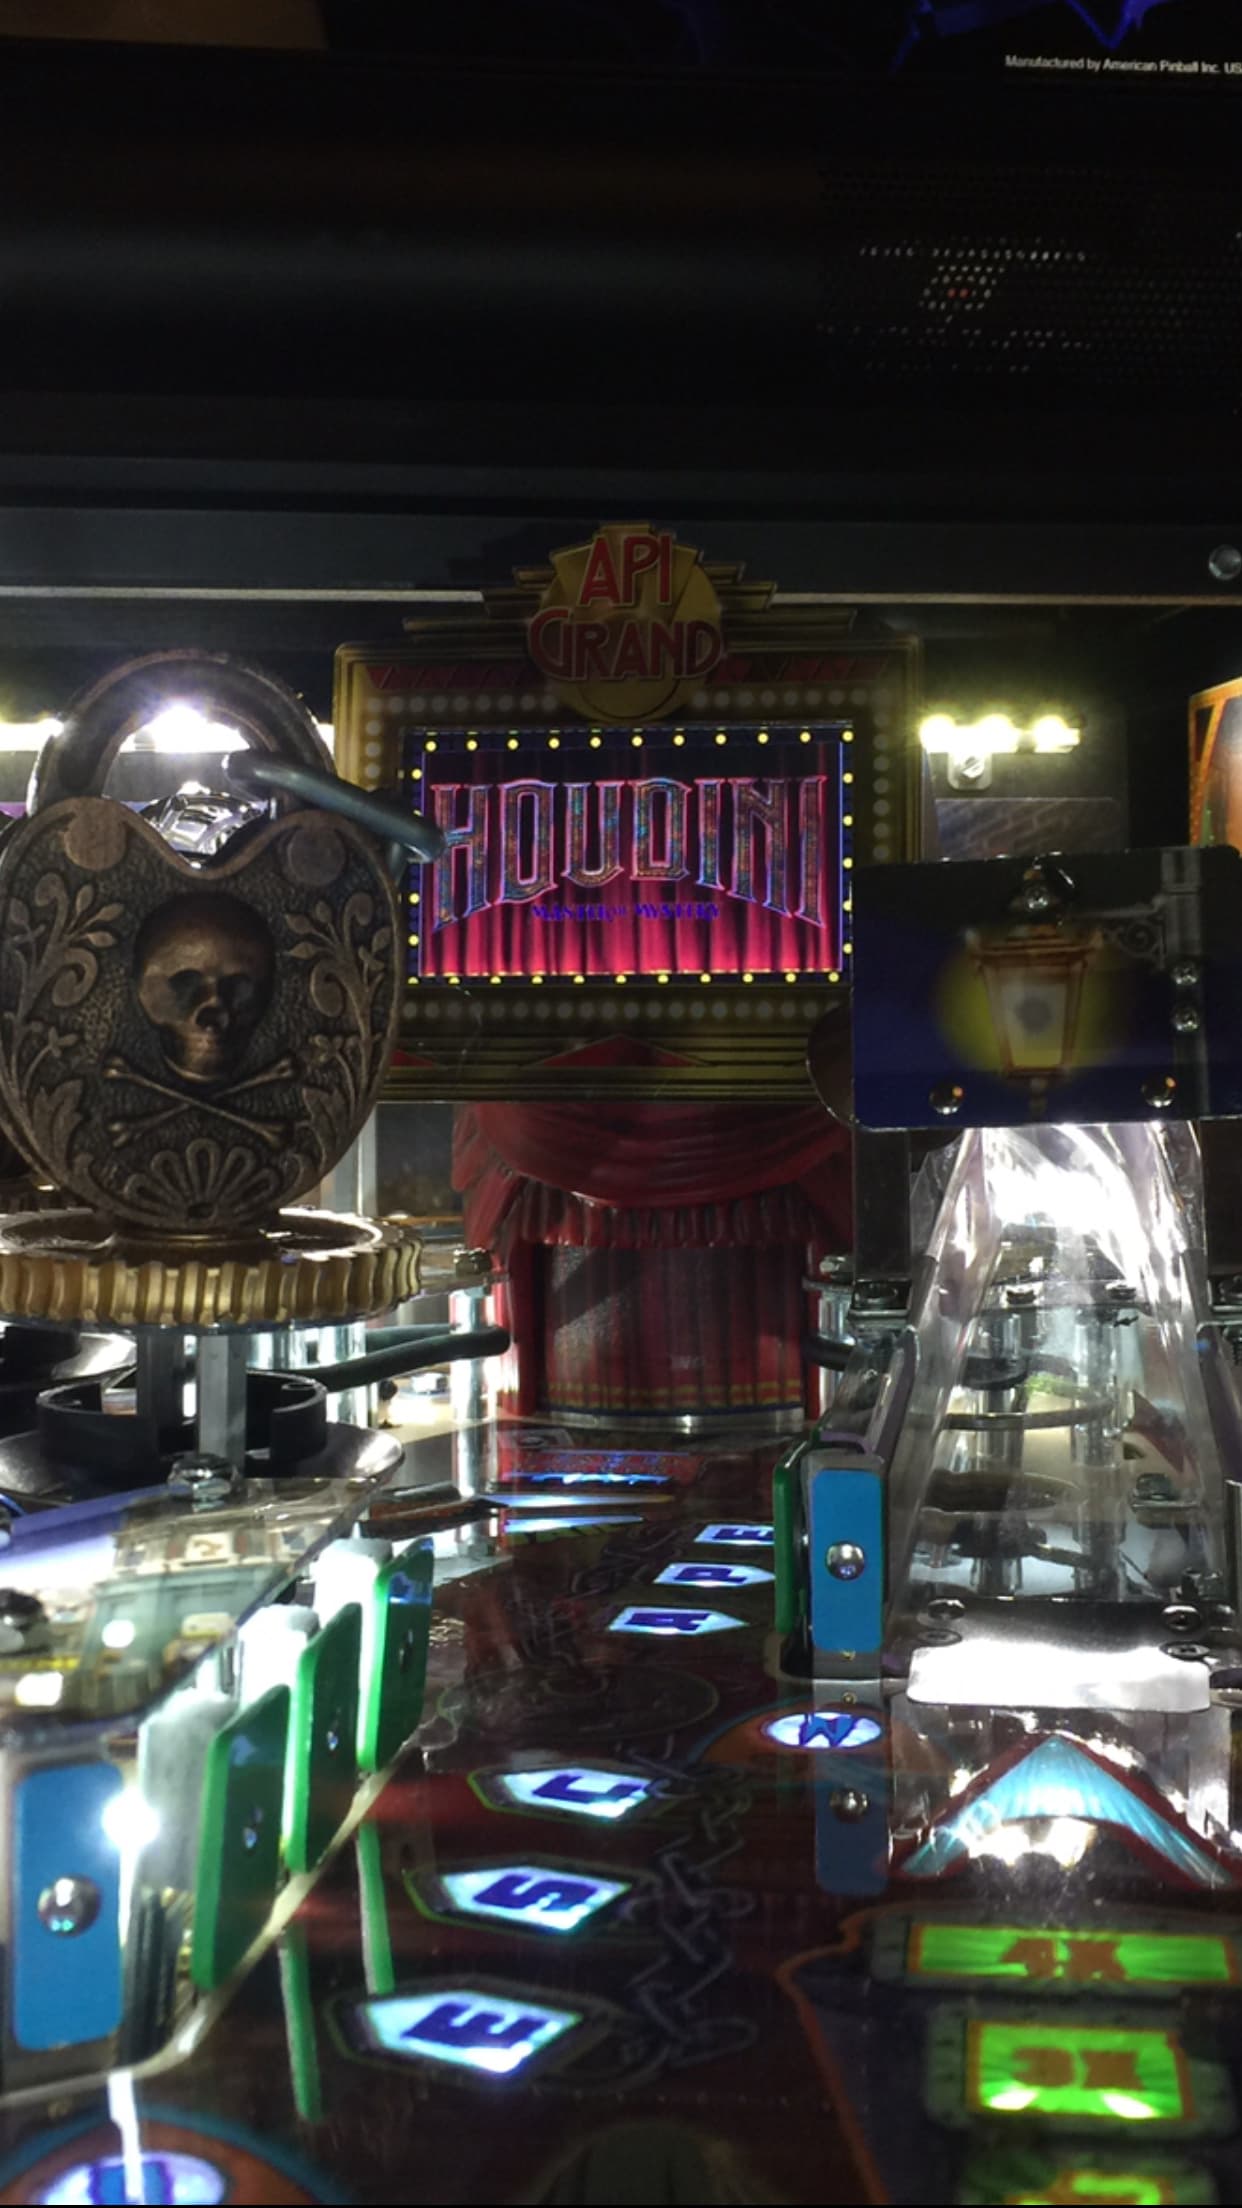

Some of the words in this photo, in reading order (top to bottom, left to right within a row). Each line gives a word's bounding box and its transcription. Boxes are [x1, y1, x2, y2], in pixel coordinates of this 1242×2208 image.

[1005, 55, 1084, 70] Manufactured
[1087, 58, 1100, 72] by
[1103, 58, 1157, 72] American
[1160, 60, 1198, 73] Pinball
[1224, 61, 1242, 75] US
[579, 534, 673, 606] API
[527, 609, 724, 682] GRAND
[430, 776, 828, 933] HOUDINI
